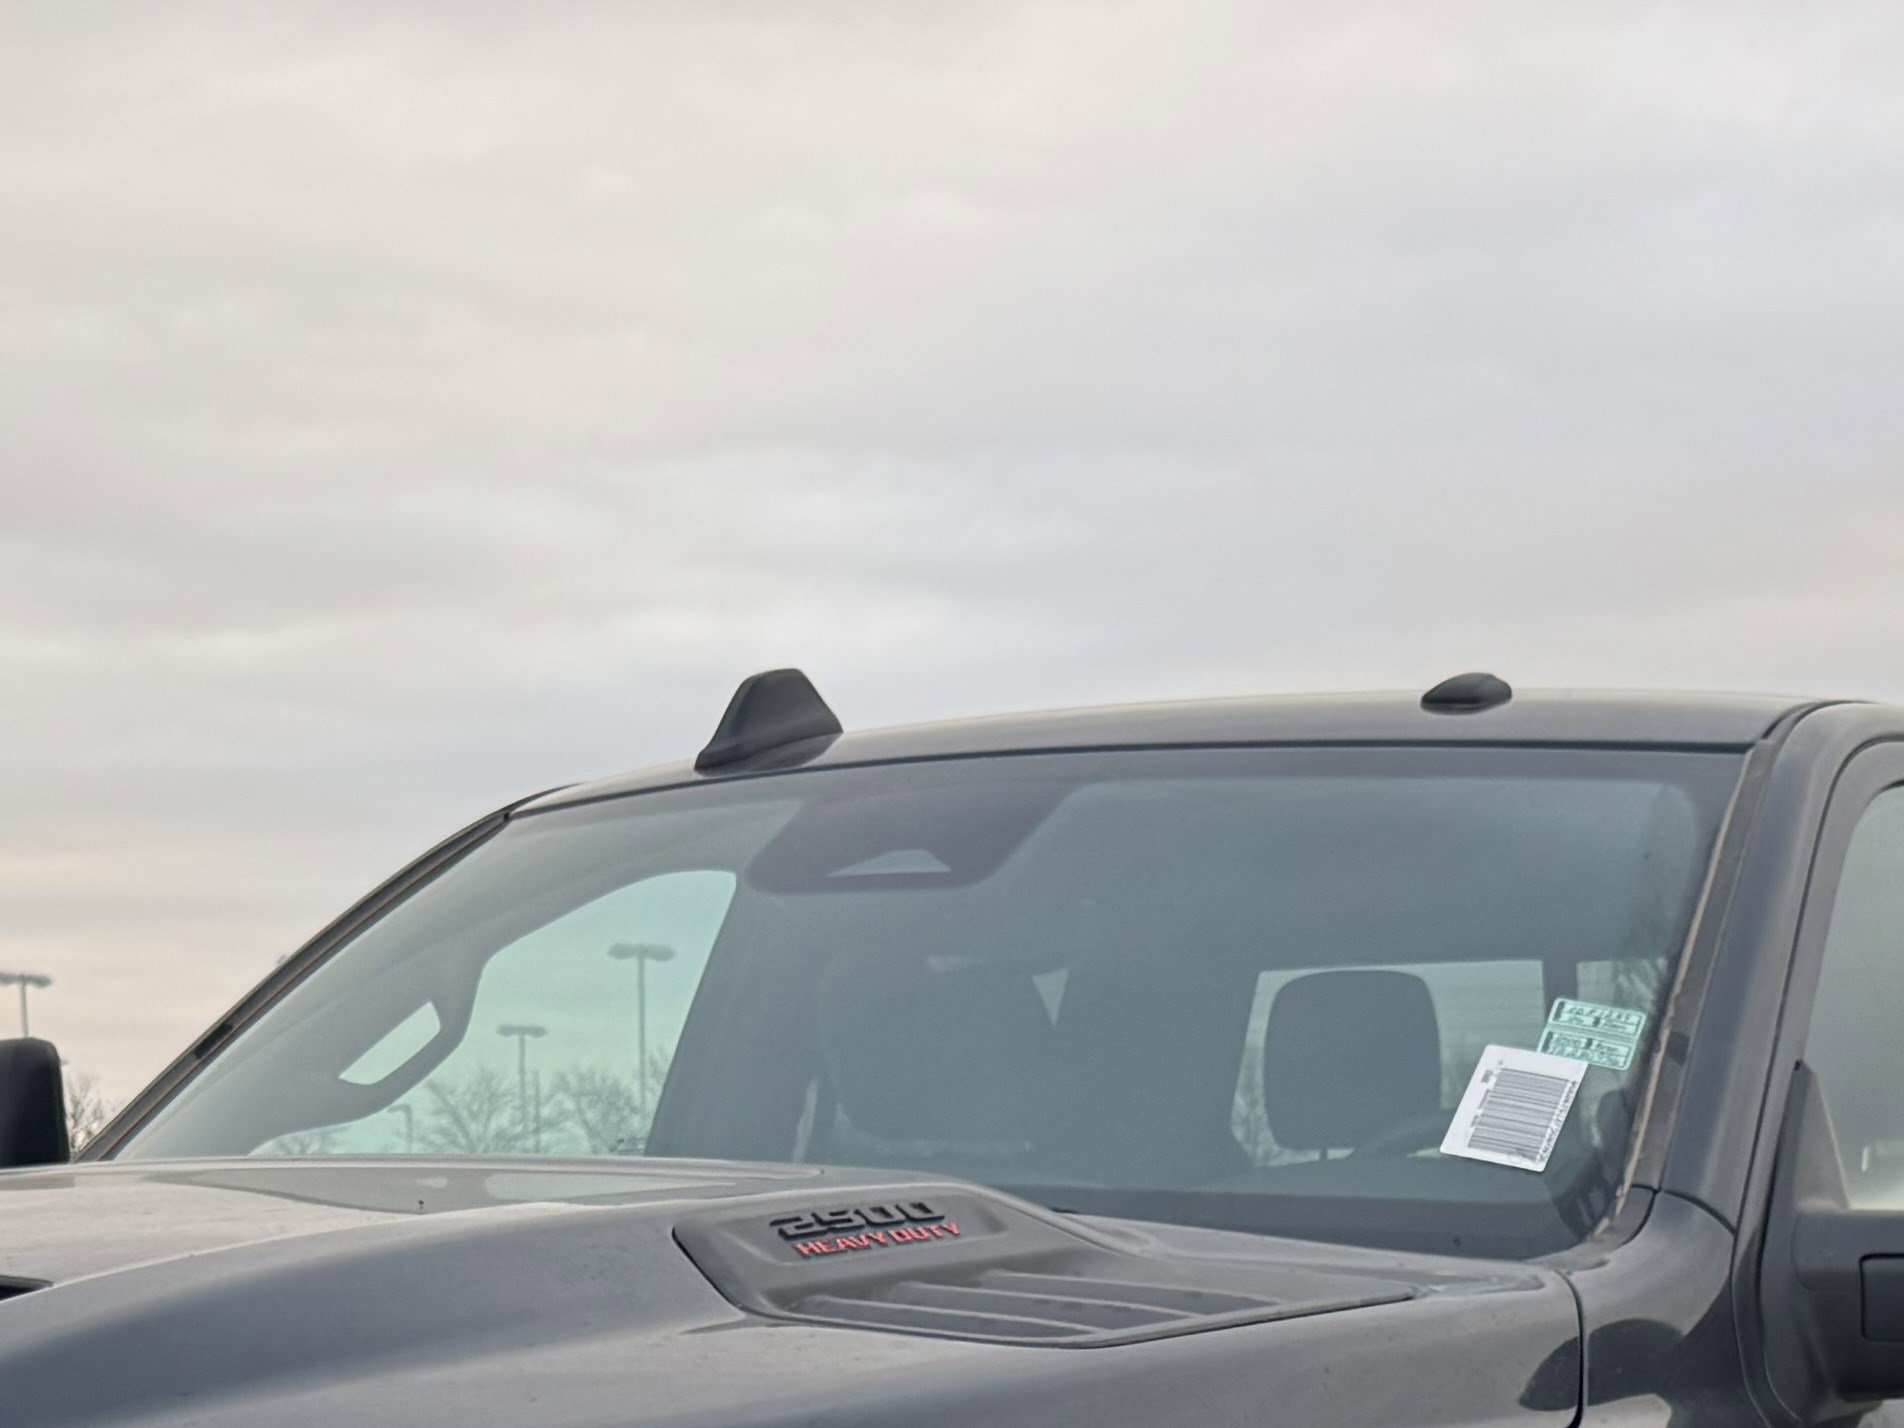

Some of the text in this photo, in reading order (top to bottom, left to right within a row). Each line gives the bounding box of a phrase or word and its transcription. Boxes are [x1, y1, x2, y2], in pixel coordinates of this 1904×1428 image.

[769, 1200, 946, 1241] 2500
[792, 1221, 961, 1258] HEAVY DUTY
